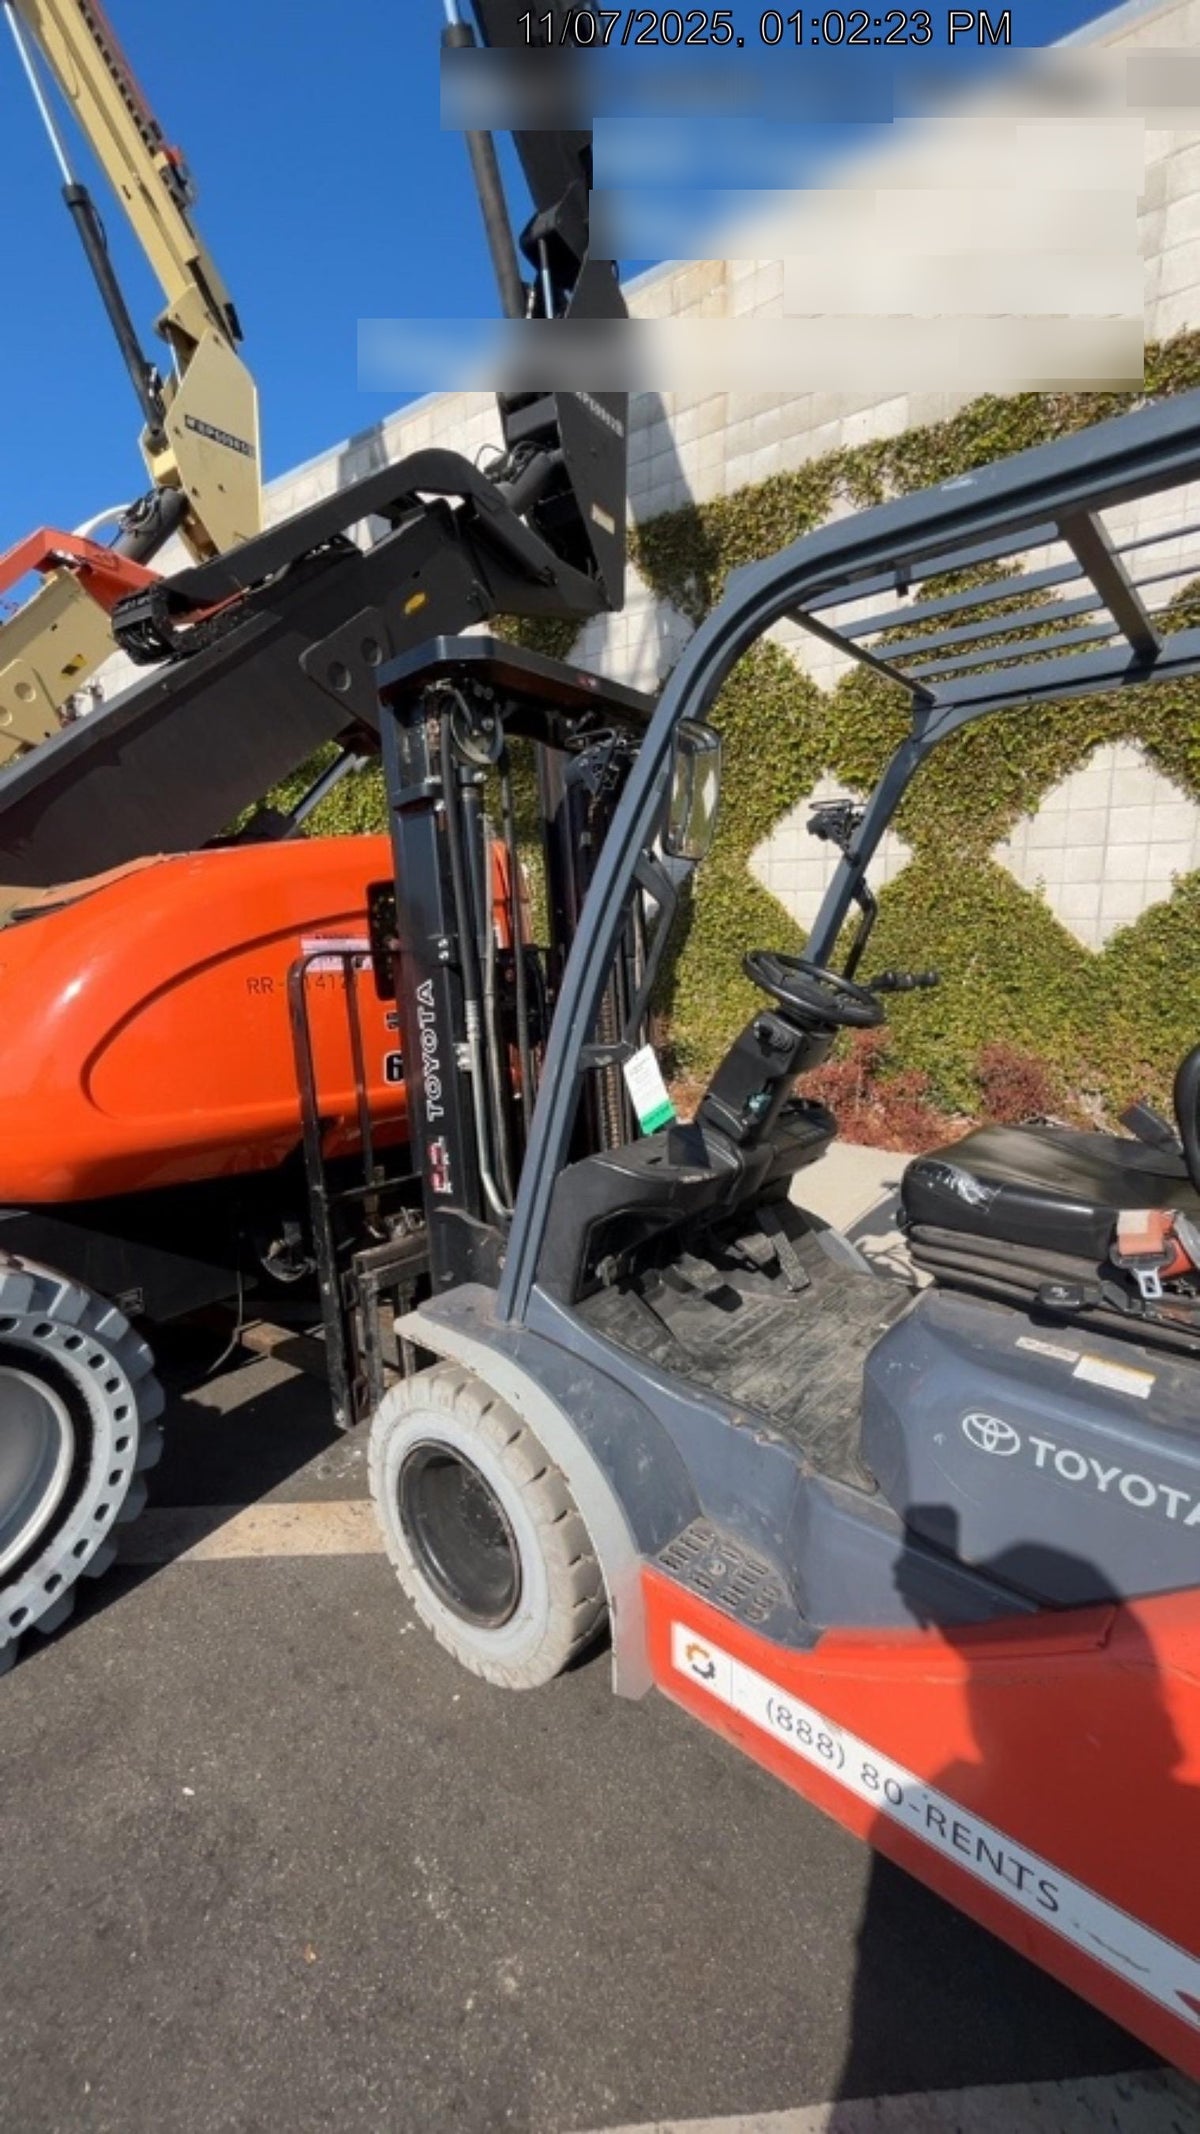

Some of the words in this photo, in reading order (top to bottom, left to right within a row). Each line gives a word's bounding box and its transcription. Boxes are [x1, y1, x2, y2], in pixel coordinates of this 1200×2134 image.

[417, 979, 444, 1122] TOYOTA
[765, 1696, 846, 1770] (888)
[861, 1763, 1060, 1913] 80-RENTS
